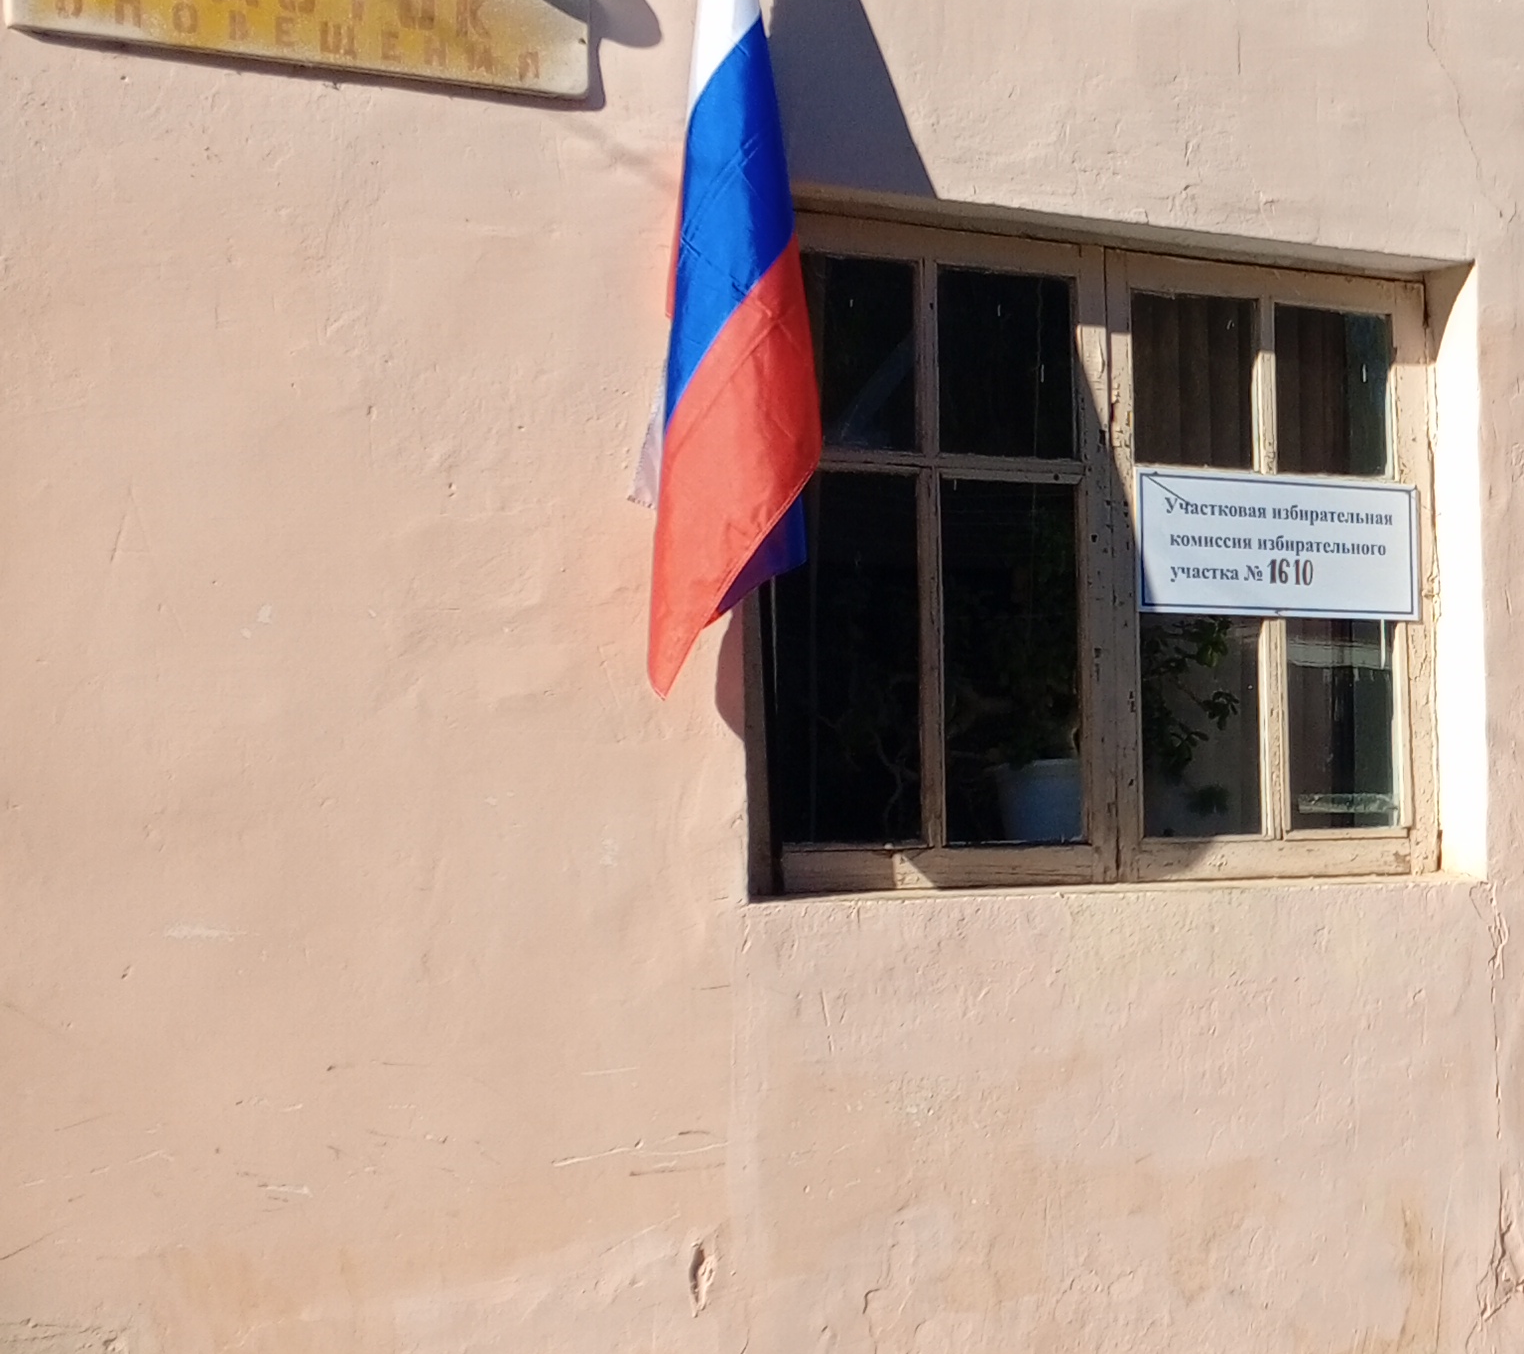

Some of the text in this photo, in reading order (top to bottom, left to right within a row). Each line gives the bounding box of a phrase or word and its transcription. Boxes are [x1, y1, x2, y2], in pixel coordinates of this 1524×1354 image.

[1164, 496, 1393, 526] Участковая избирательная
[1170, 533, 1386, 556] комиссия избирательного
[1170, 558, 1314, 586] участка № 1610
